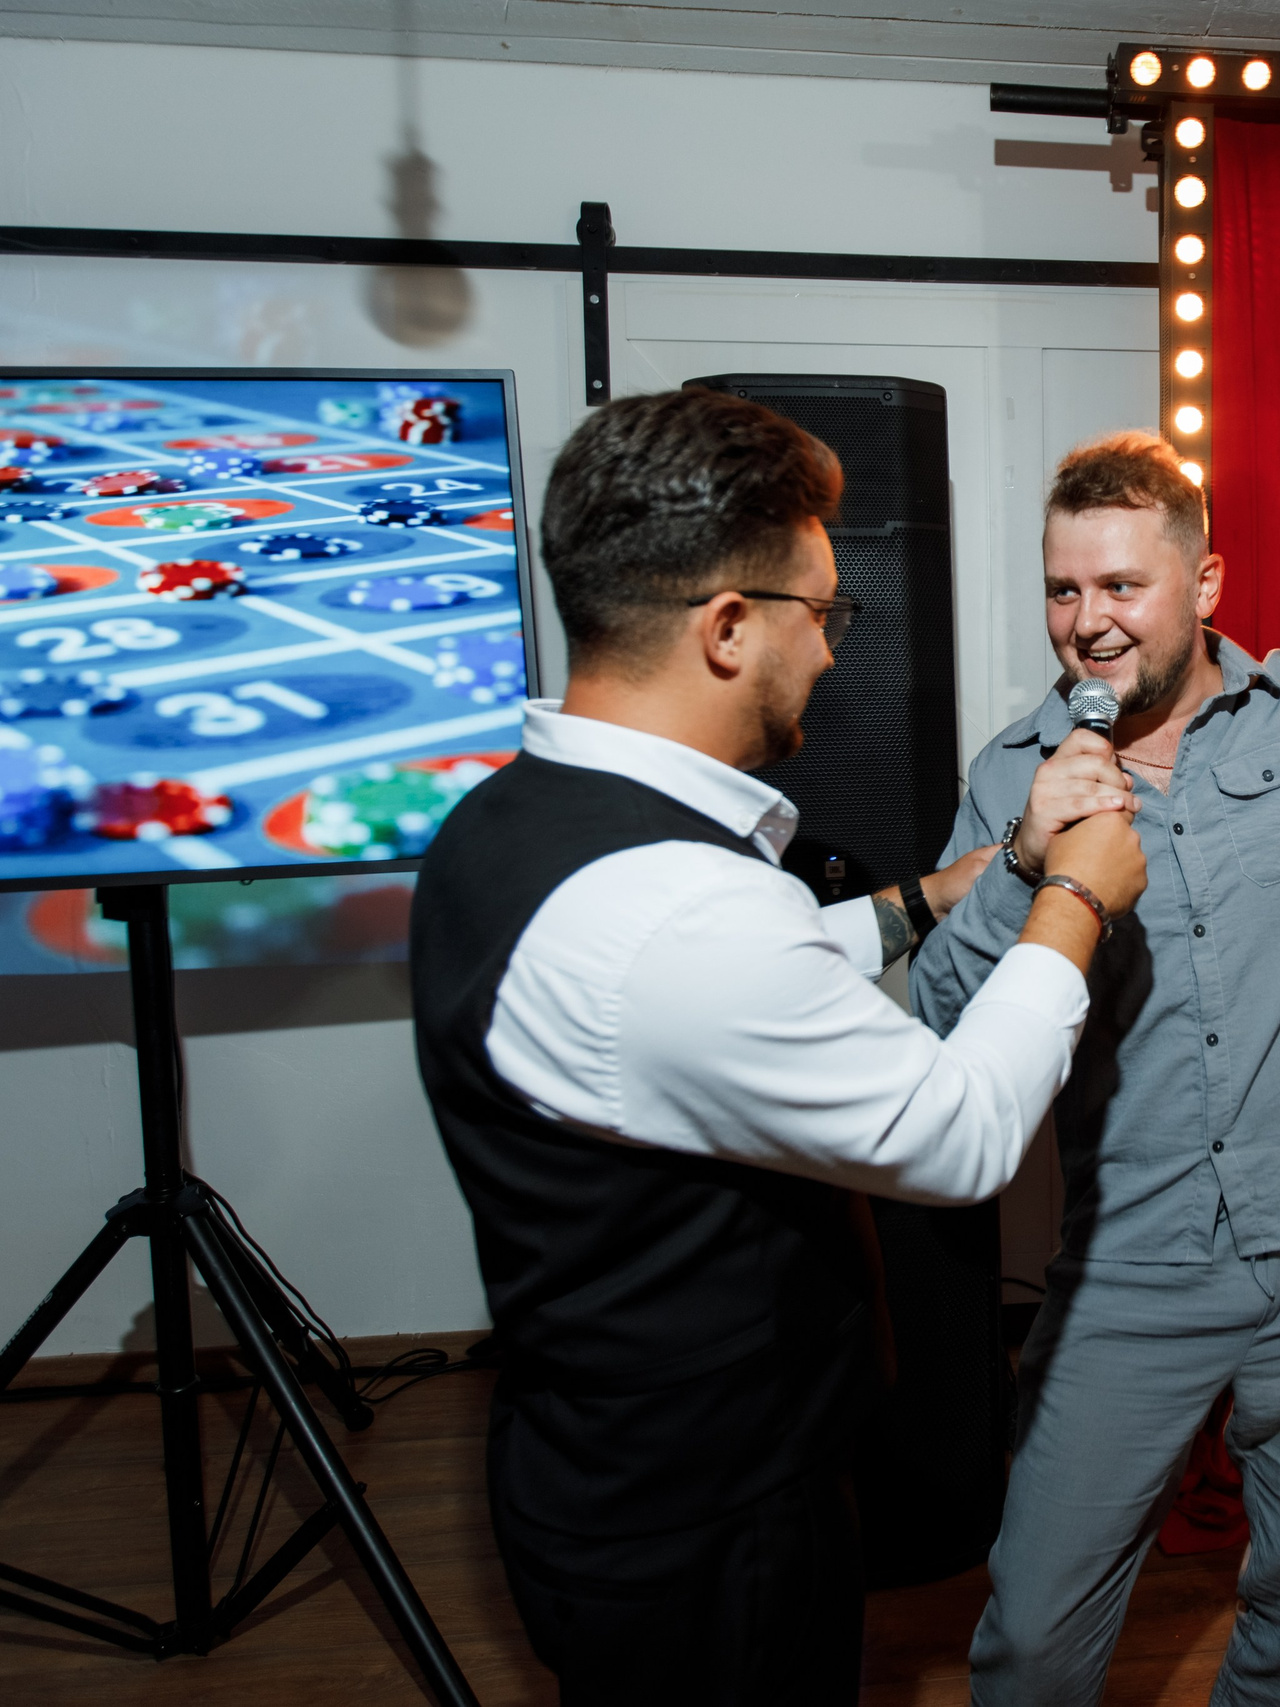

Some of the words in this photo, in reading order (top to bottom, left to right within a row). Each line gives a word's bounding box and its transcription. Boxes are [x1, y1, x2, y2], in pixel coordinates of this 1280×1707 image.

[381, 478, 484, 497] 24
[15, 617, 181, 663] 28
[155, 680, 329, 736] 31
